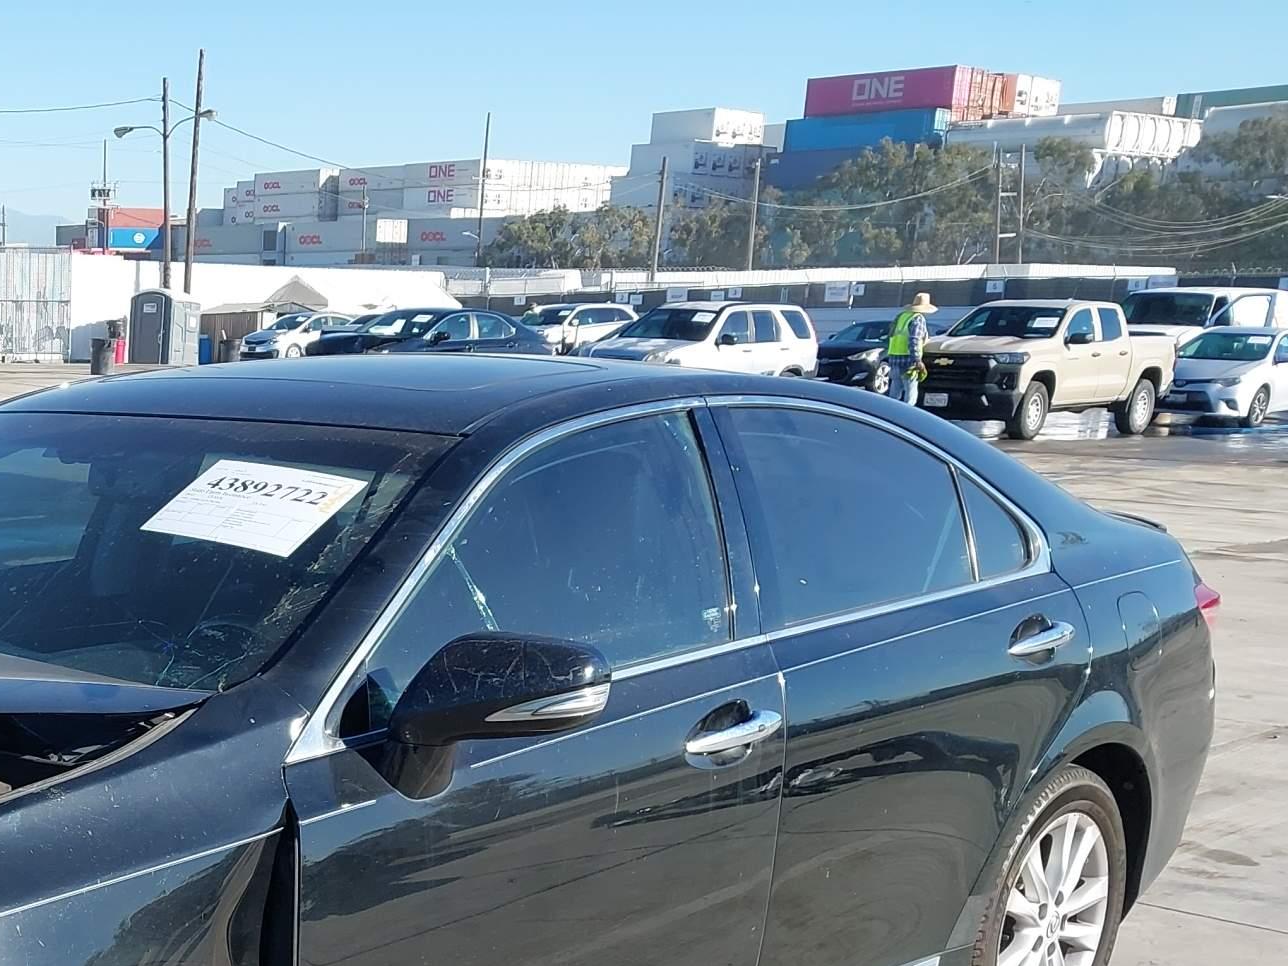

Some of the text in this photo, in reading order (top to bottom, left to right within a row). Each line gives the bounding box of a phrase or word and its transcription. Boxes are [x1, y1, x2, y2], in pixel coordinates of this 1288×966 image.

[852, 76, 905, 101] ONE
[429, 164, 456, 179] ONE
[263, 181, 281, 190] OOCL
[349, 178, 367, 186] OOCL
[427, 189, 454, 204] ONE
[263, 203, 280, 213] OOCL
[298, 234, 322, 246] OOCL
[420, 231, 447, 242] OOCL
[207, 476, 329, 505] 43892722
